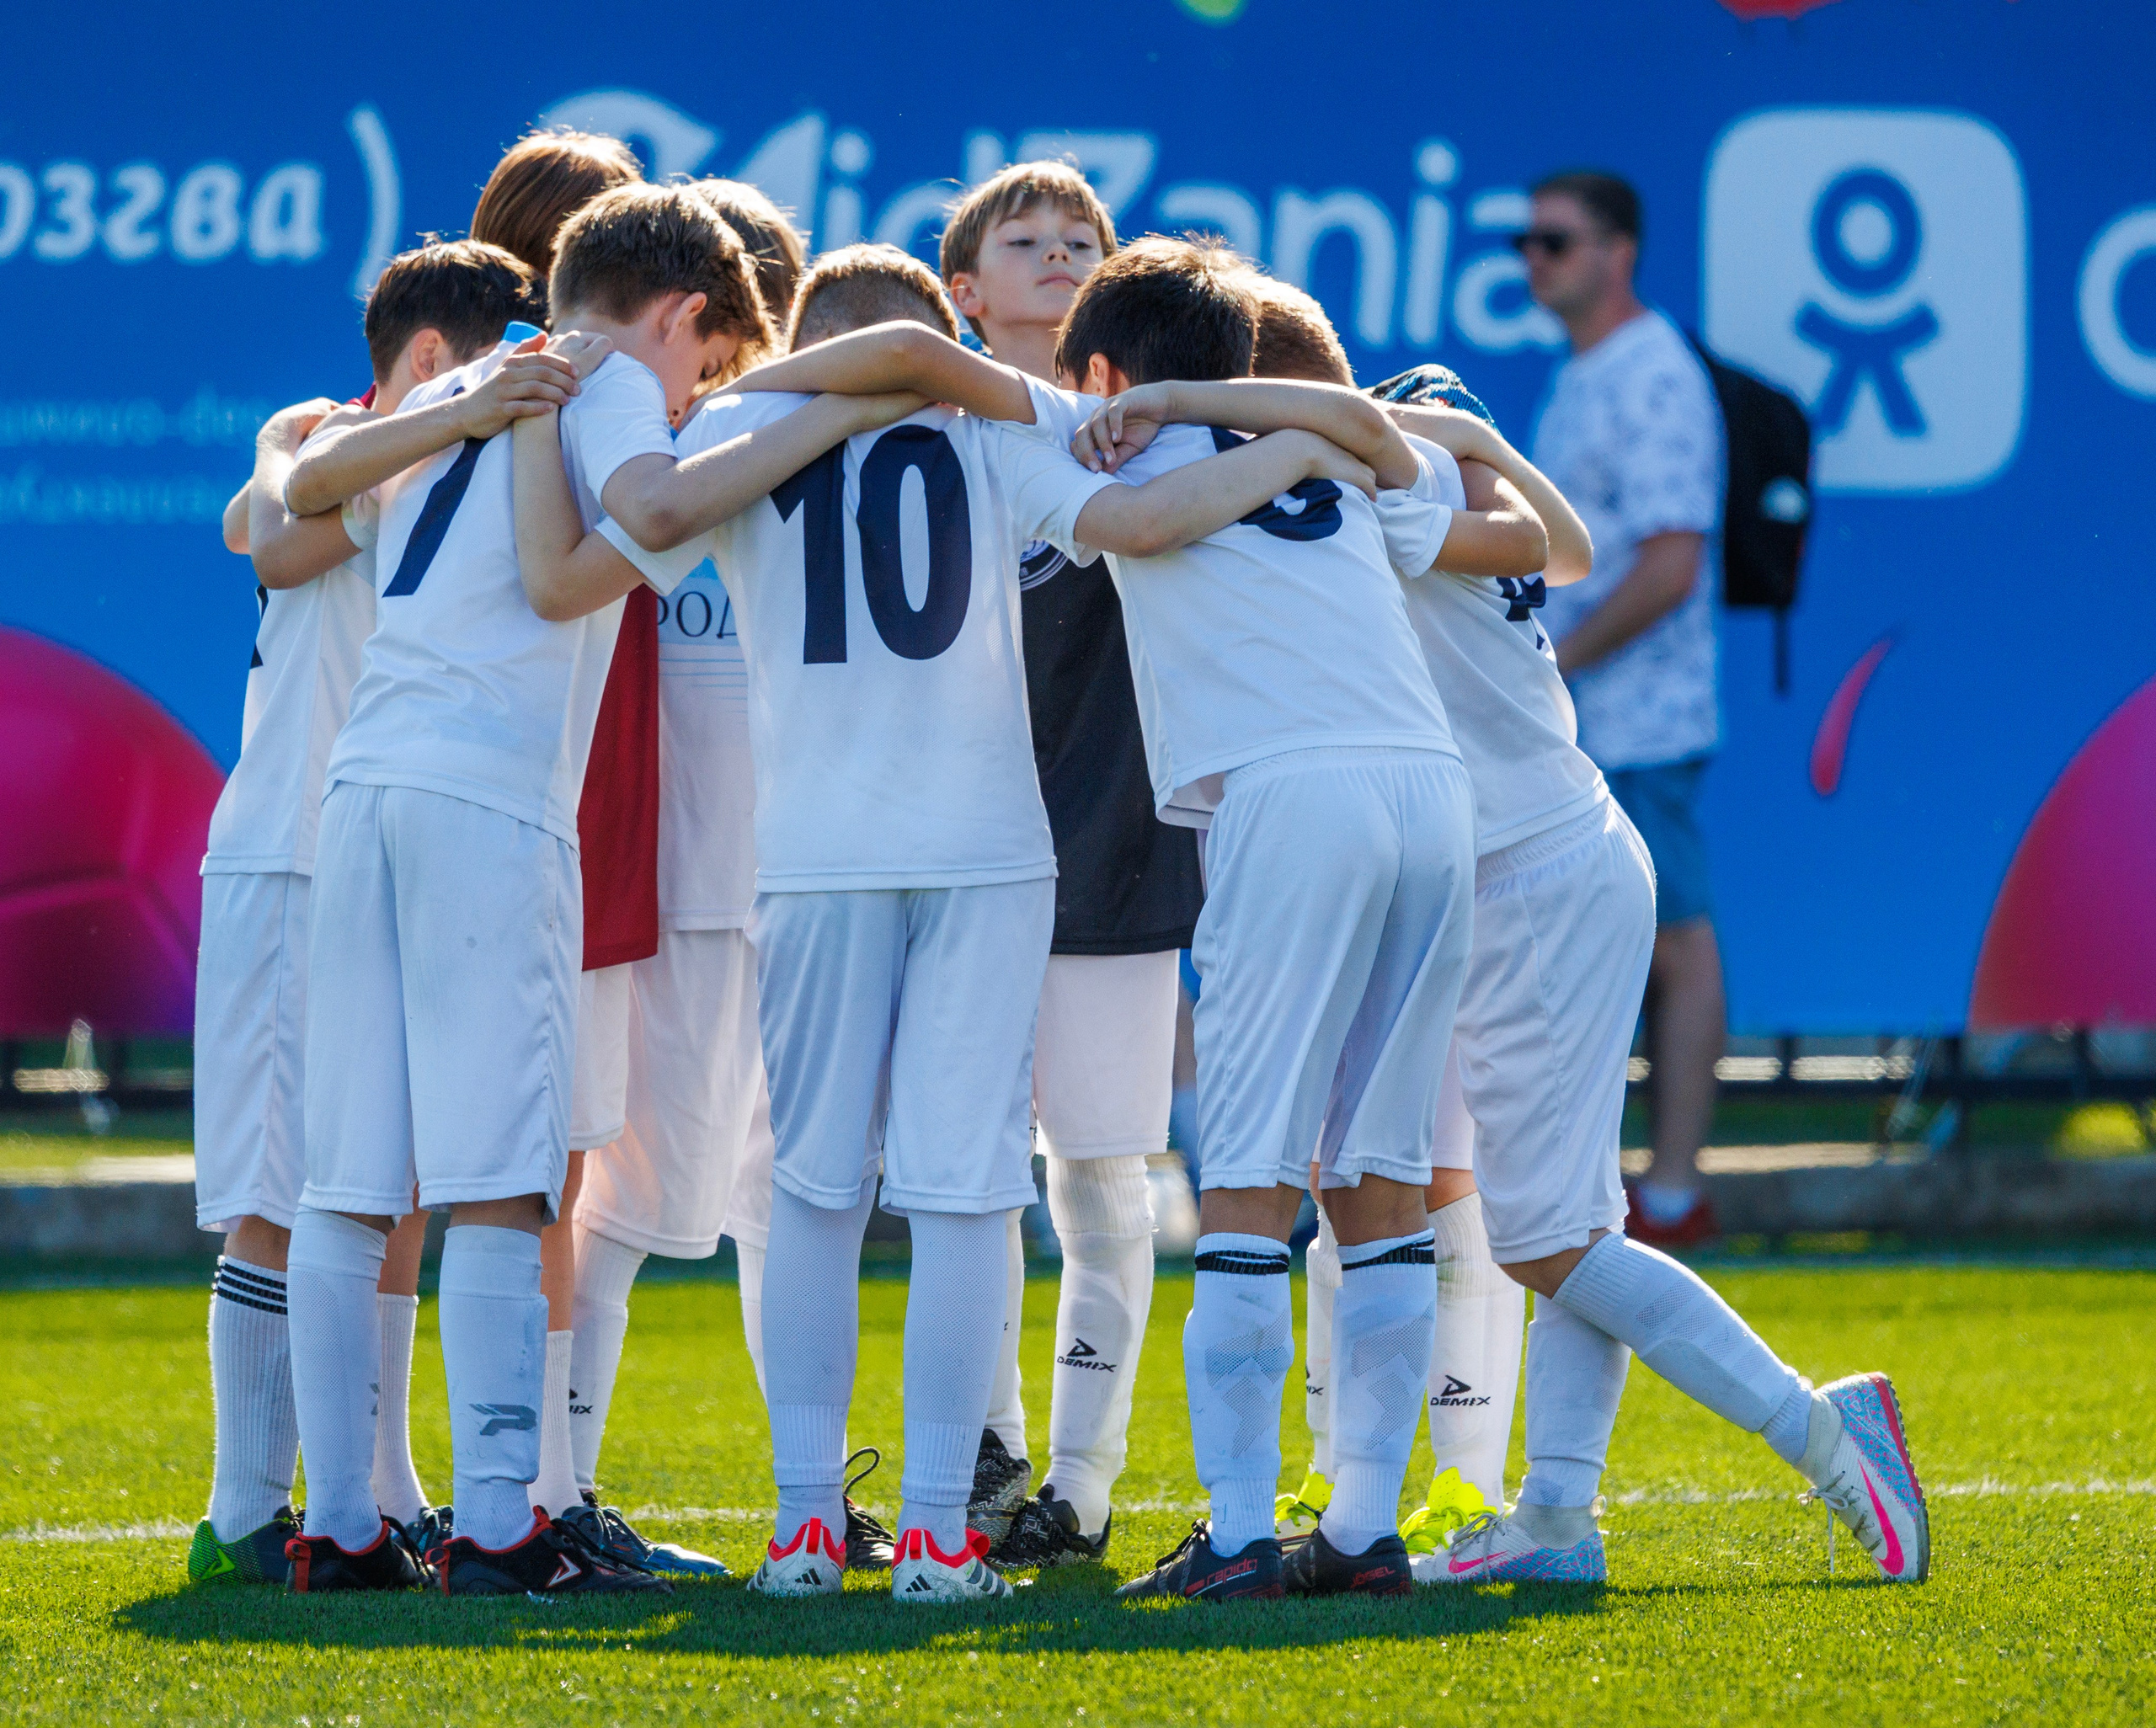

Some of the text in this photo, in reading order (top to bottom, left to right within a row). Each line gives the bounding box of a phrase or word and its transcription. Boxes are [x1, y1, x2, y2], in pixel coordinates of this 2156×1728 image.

[768, 424, 973, 664] 10
[1057, 1356, 1117, 1373] DEMIX
[1430, 1396, 1491, 1406] DEMIX
[1206, 1558, 1258, 1587] rapido
